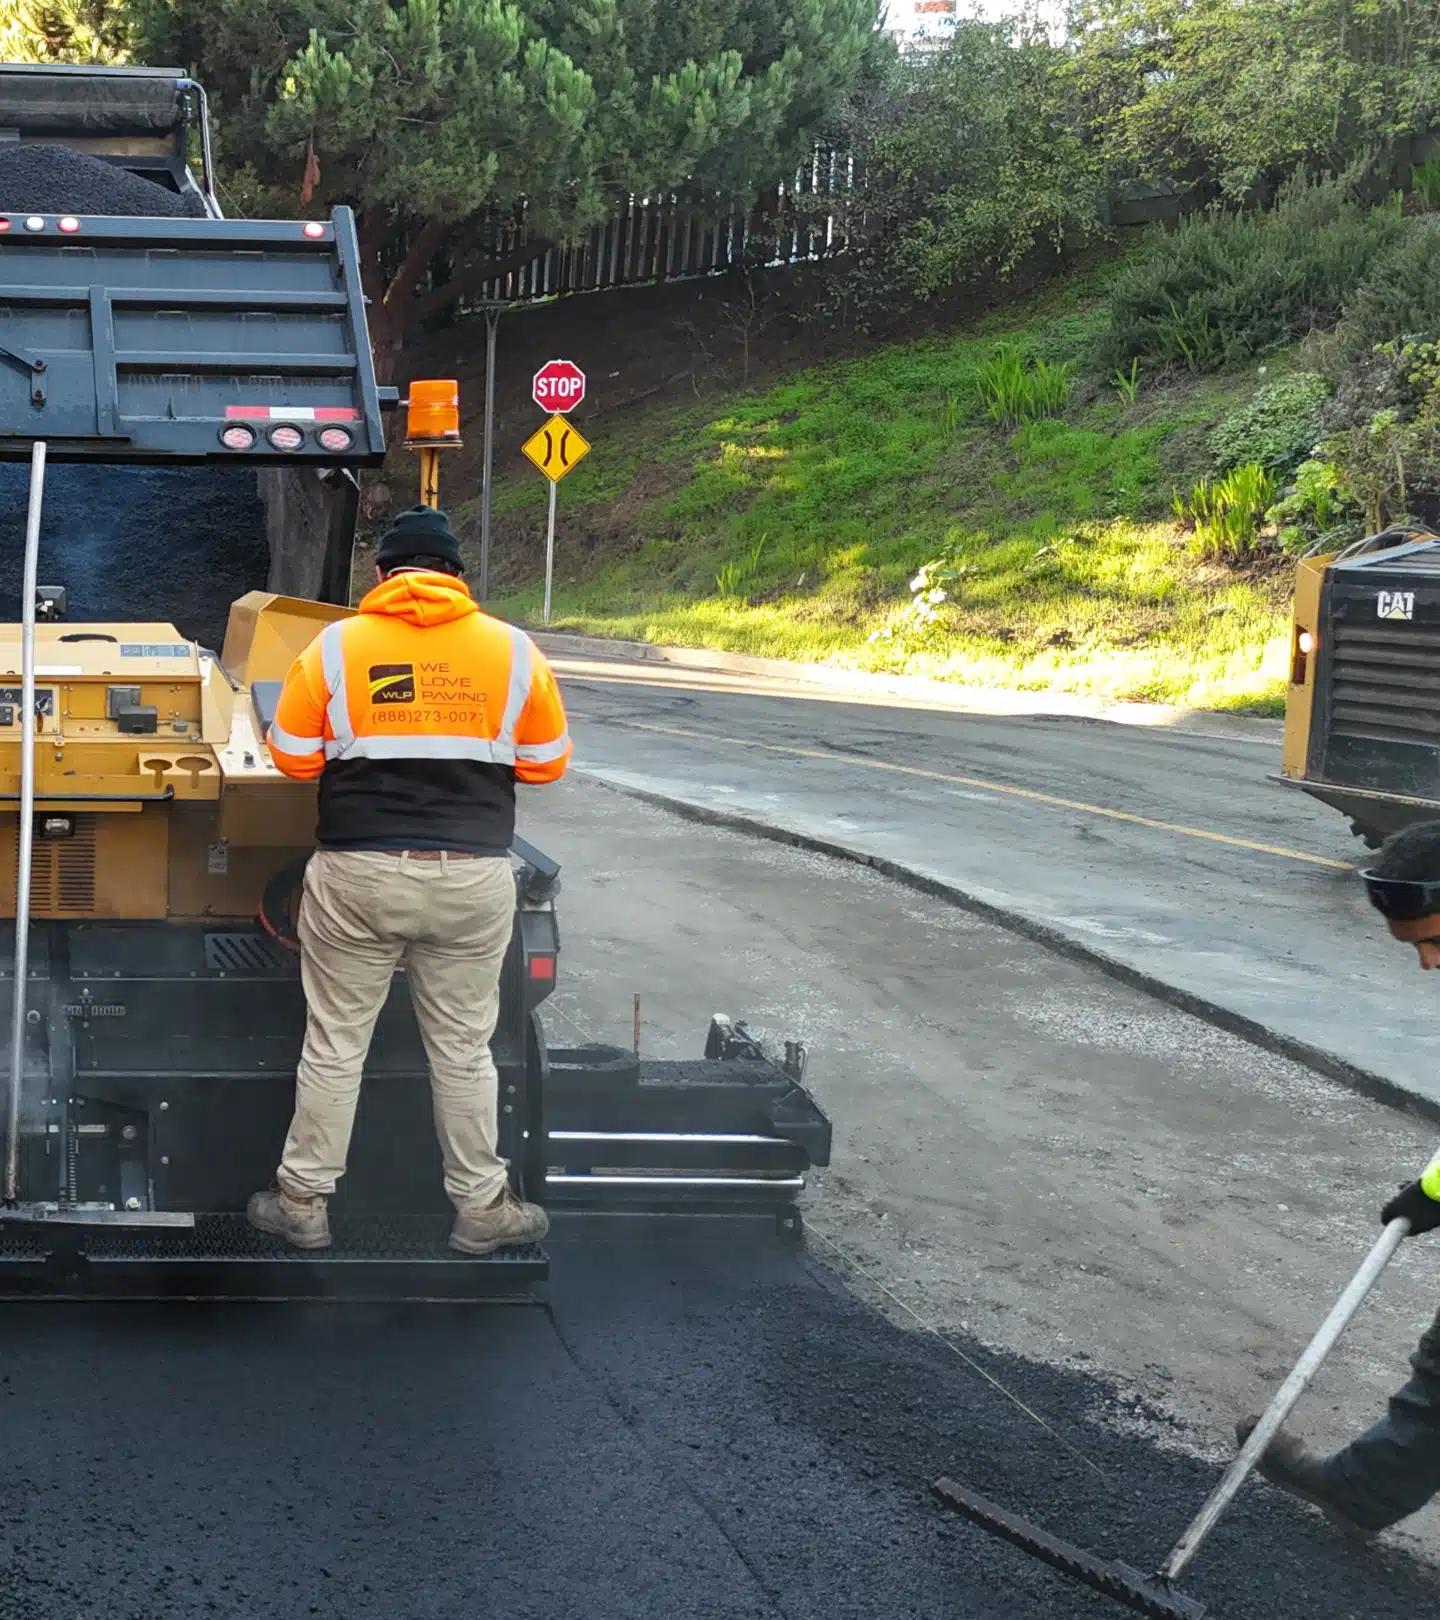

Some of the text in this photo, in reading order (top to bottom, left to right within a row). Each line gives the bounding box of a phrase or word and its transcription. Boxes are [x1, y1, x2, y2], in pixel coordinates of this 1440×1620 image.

[537, 377, 581, 397] STOP
[1377, 590, 1415, 620] CAT
[420, 662, 450, 673] WE
[420, 676, 472, 688] LOVE
[382, 691, 413, 700] WLP
[421, 691, 488, 703] PAVING
